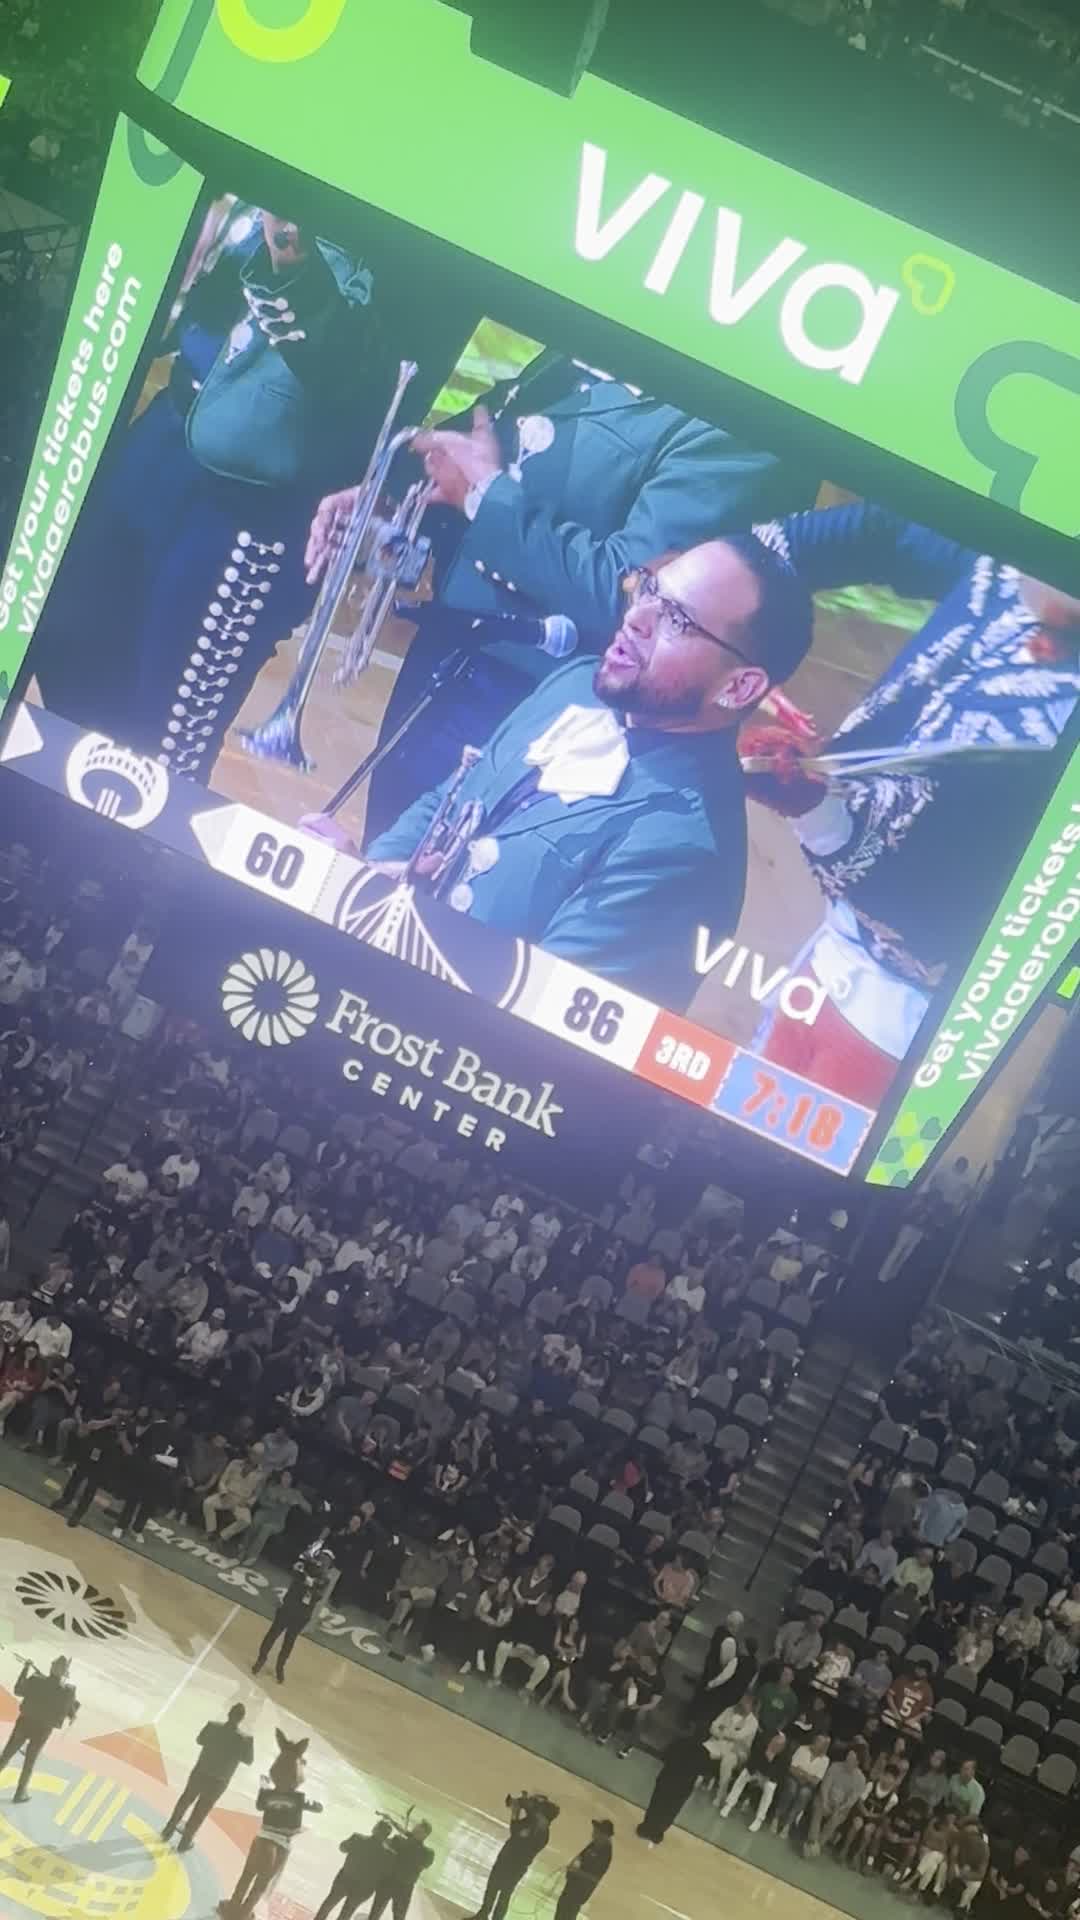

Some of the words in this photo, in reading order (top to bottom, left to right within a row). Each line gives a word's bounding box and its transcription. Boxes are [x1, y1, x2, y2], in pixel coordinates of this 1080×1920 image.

[574, 140, 900, 386] viva
[15, 469, 52, 564] your
[43, 339, 94, 465] tickets
[83, 241, 124, 335] here
[17, 275, 142, 634] vivaaerobus.com
[245, 831, 305, 892] 60
[694, 924, 828, 1027] viva
[914, 1026, 964, 1089] Get
[953, 943, 1012, 1024] your
[1002, 823, 1080, 939] tickets
[325, 989, 444, 1078] Frost
[443, 1046, 565, 1138] Bank
[563, 986, 625, 1046] 86
[655, 1034, 711, 1081] 3RD
[342, 1059, 507, 1152] CENTER
[742, 1071, 844, 1151] 7:18
[899, 1696, 917, 1718] 5
